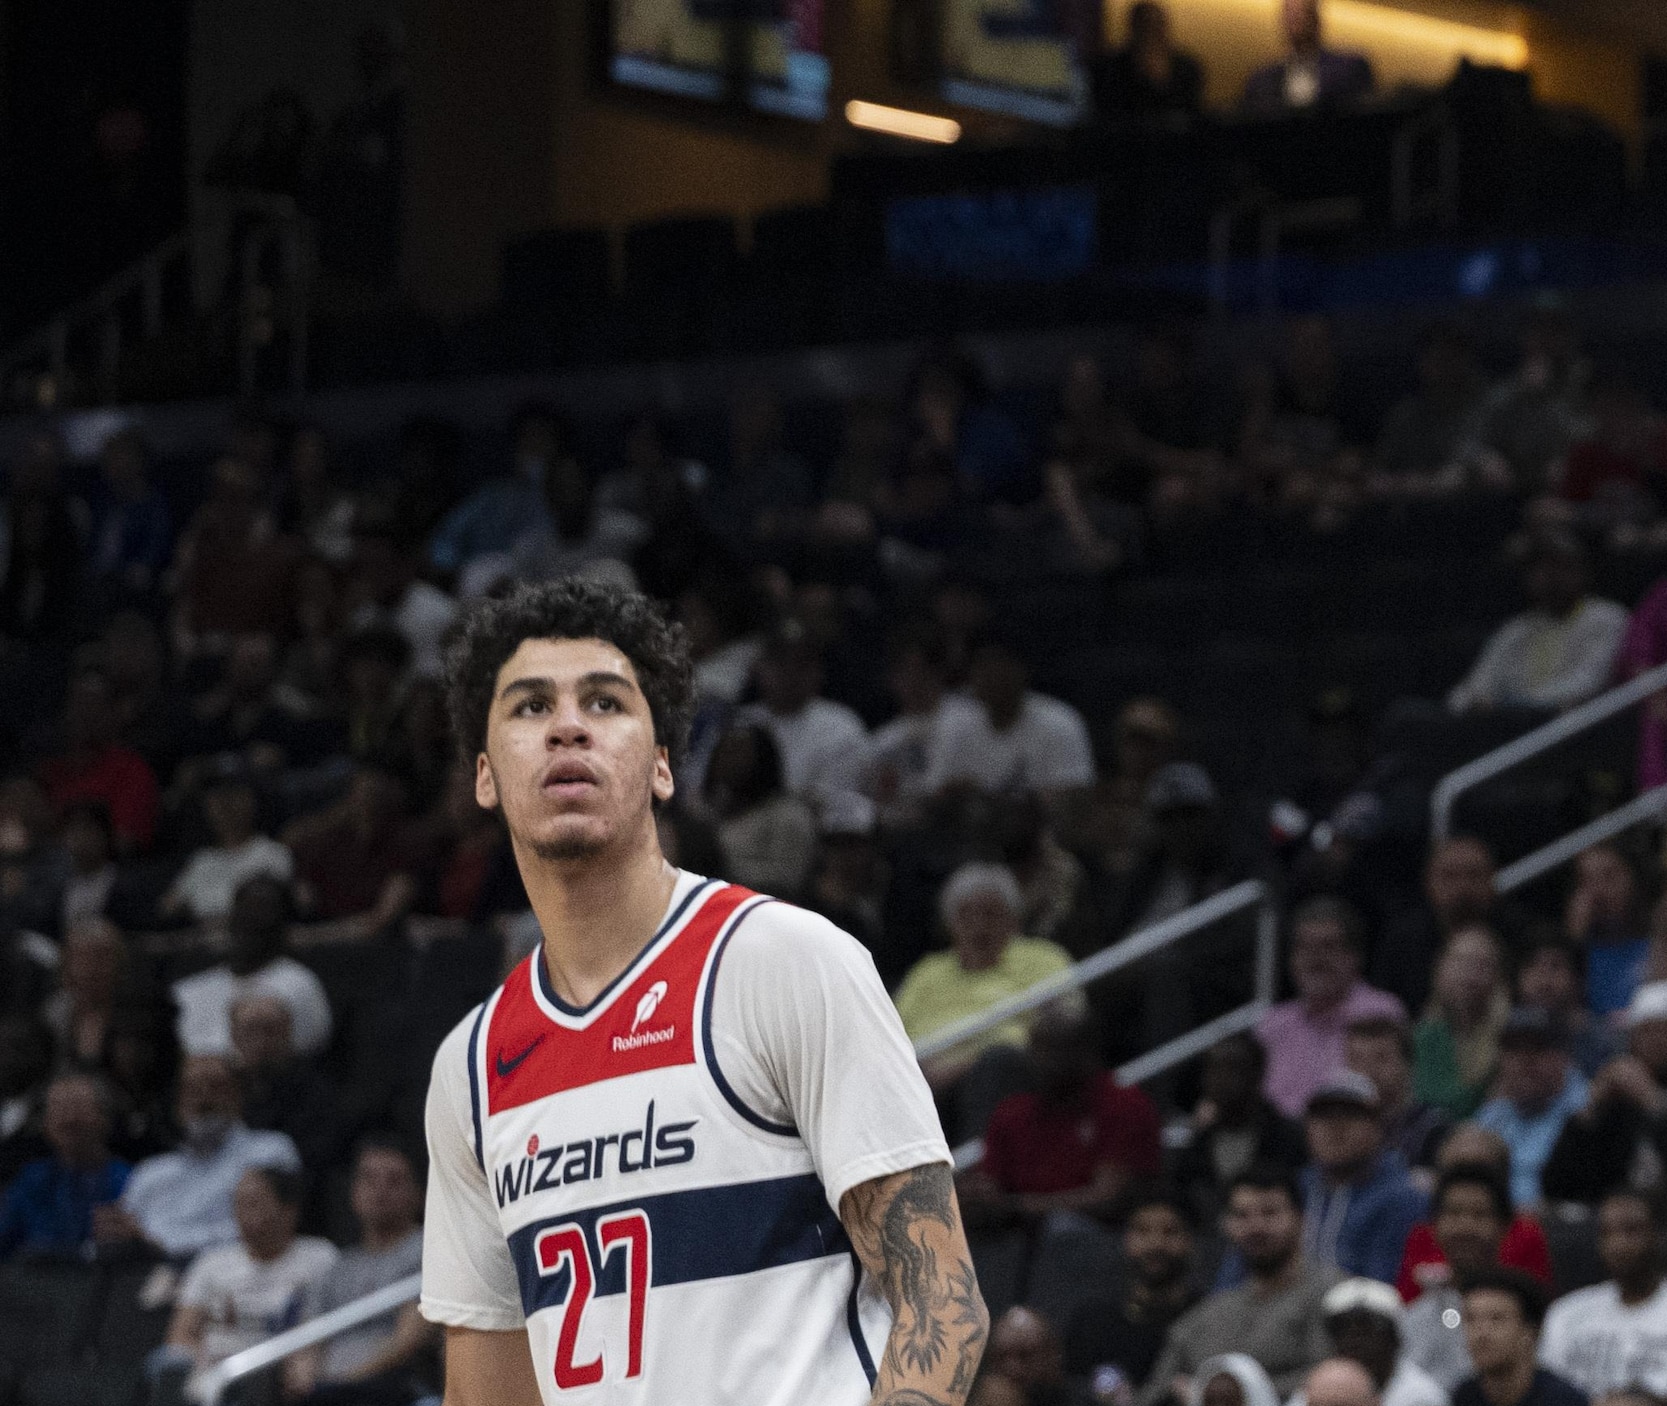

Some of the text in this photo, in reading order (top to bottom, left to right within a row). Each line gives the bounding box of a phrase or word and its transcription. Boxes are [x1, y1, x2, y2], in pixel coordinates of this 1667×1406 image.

[612, 1024, 675, 1053] Robinhood
[496, 1098, 700, 1207] wizards
[534, 1207, 653, 1390] 27
